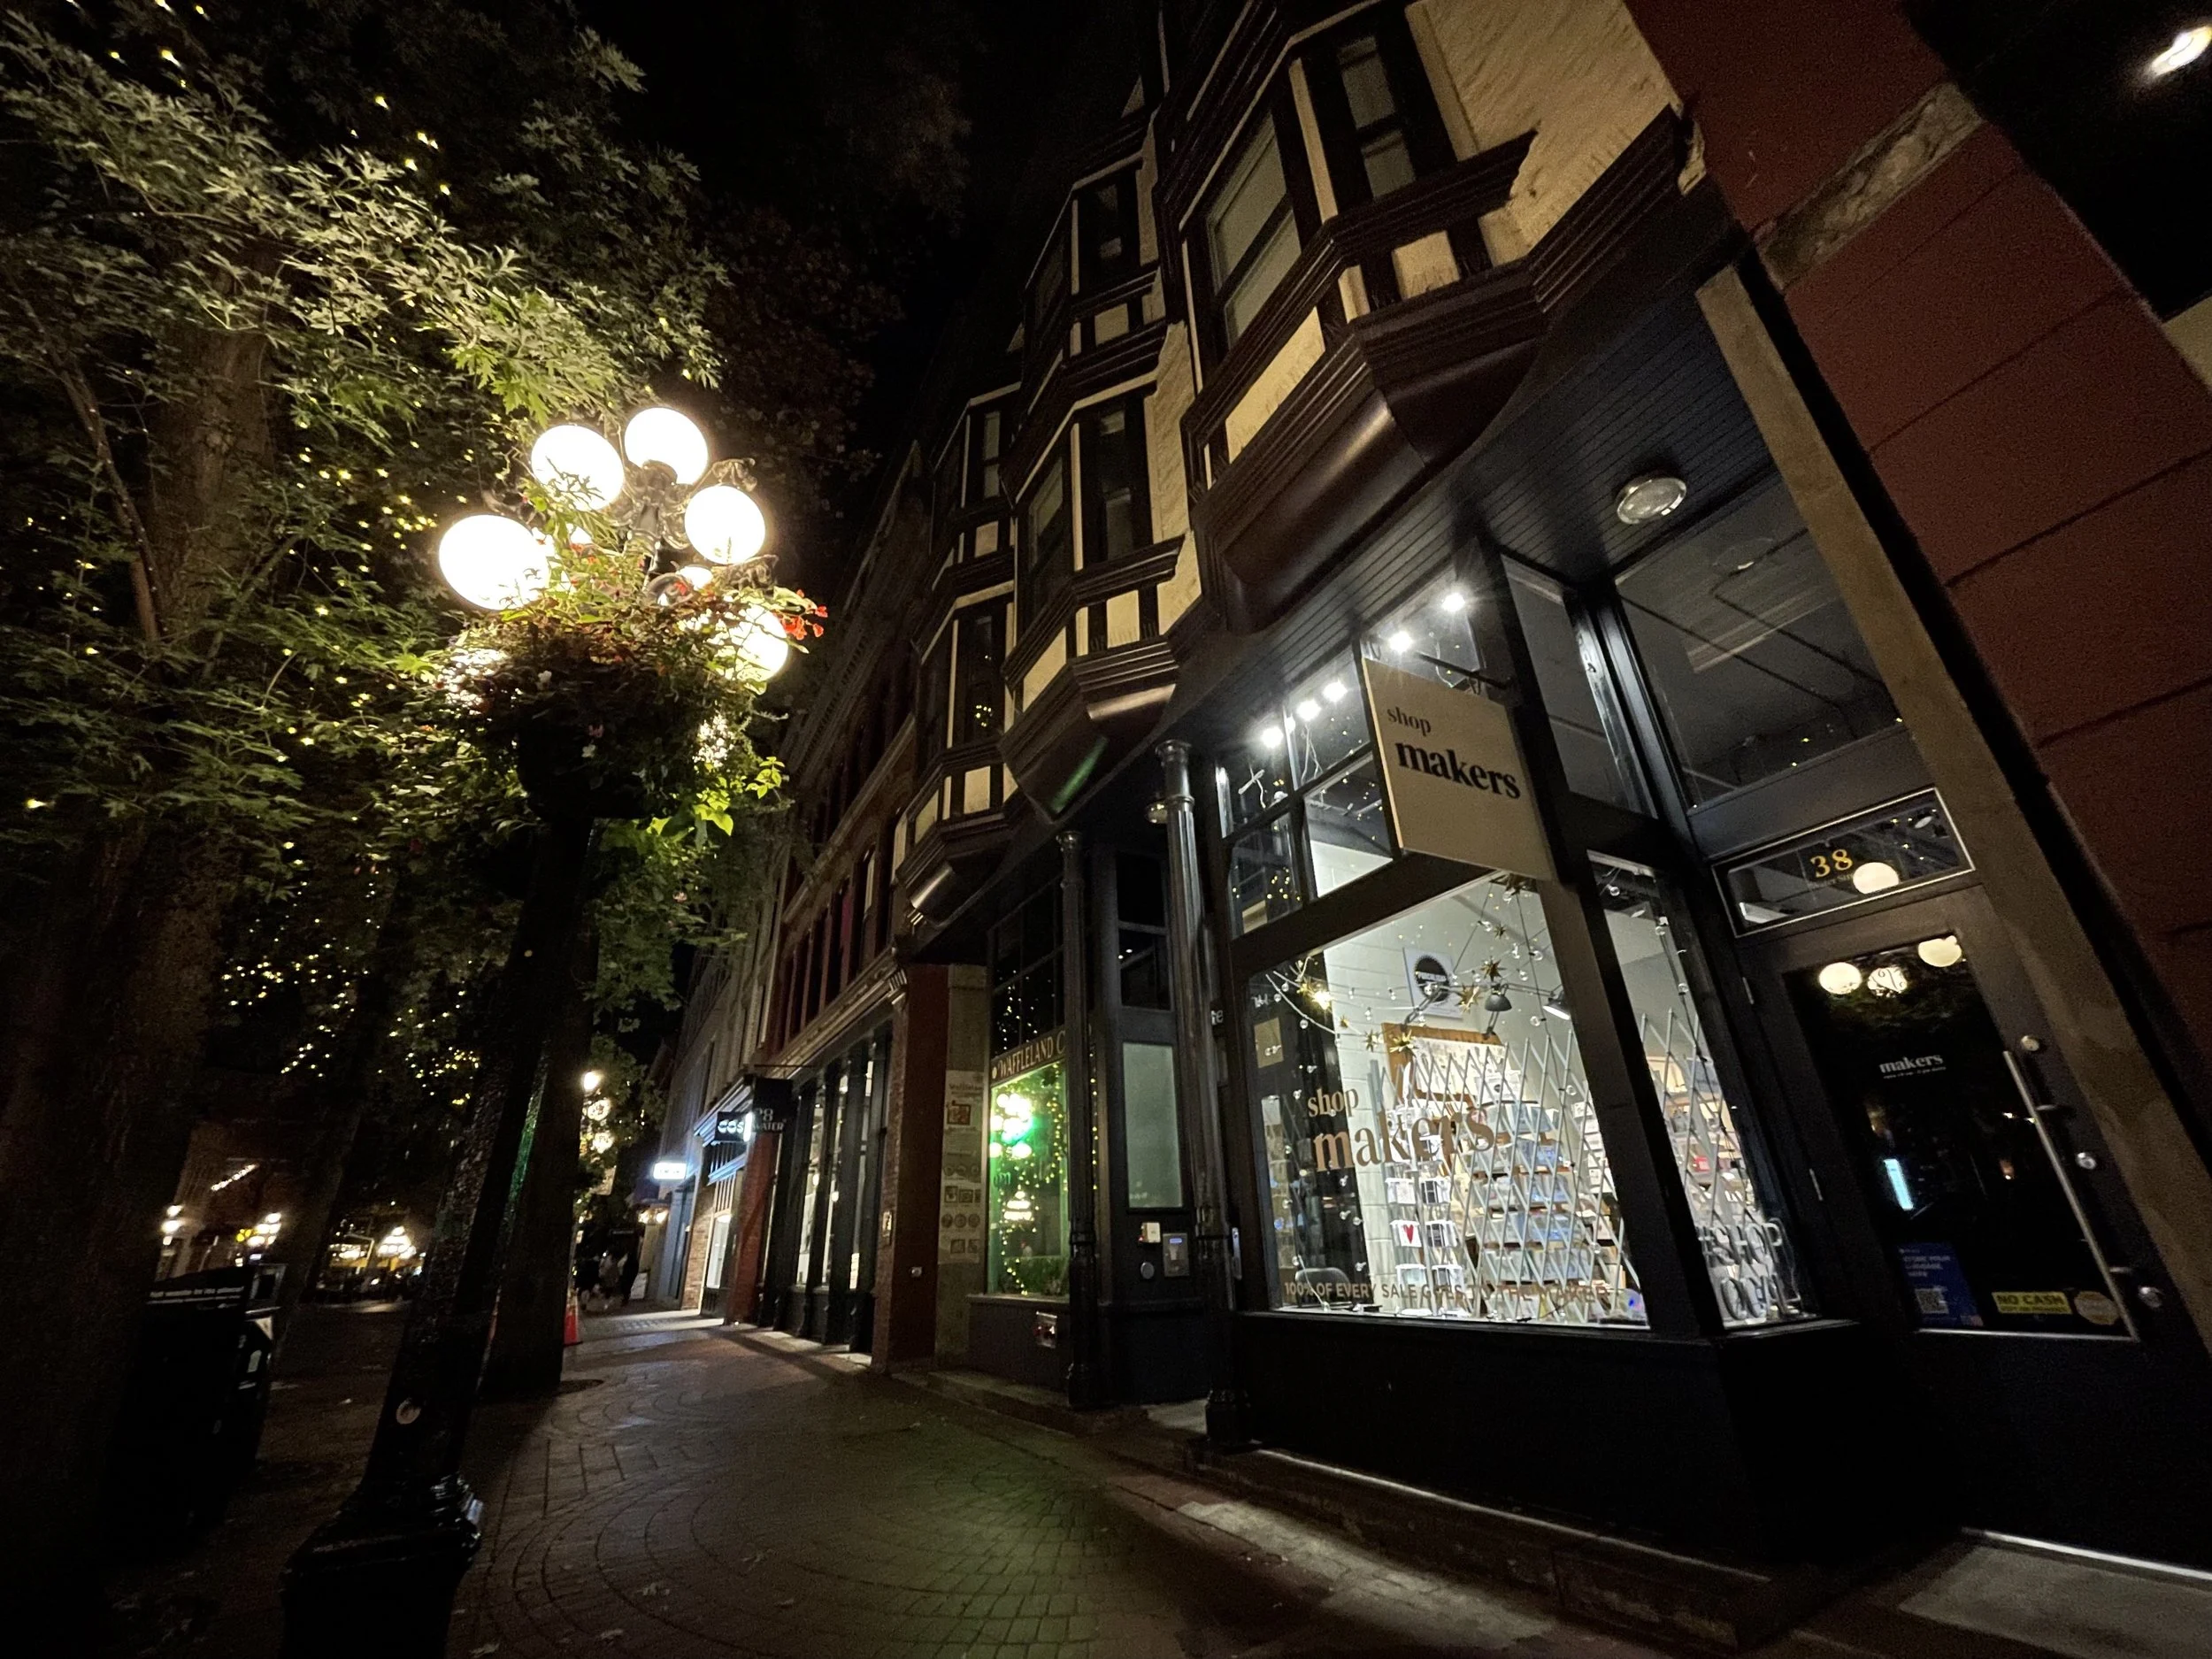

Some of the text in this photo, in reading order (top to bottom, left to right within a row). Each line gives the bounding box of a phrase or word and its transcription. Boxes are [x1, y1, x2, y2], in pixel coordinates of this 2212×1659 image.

[1386, 706, 1432, 736] shop
[1395, 742, 1521, 799] makers
[1809, 849, 1854, 878] 38
[997, 1035, 1054, 1078] WAFFLELAND
[1878, 1055, 1944, 1073] makers
[1307, 1087, 1359, 1118] shop
[1313, 1107, 1494, 1172] makers
[1284, 1282, 1314, 1296] 100%
[1317, 1283, 1333, 1297] OF
[1335, 1283, 1377, 1299] EVERY
[1382, 1284, 1417, 1299] SALE
[1996, 1294, 2065, 1306] NO CASH
